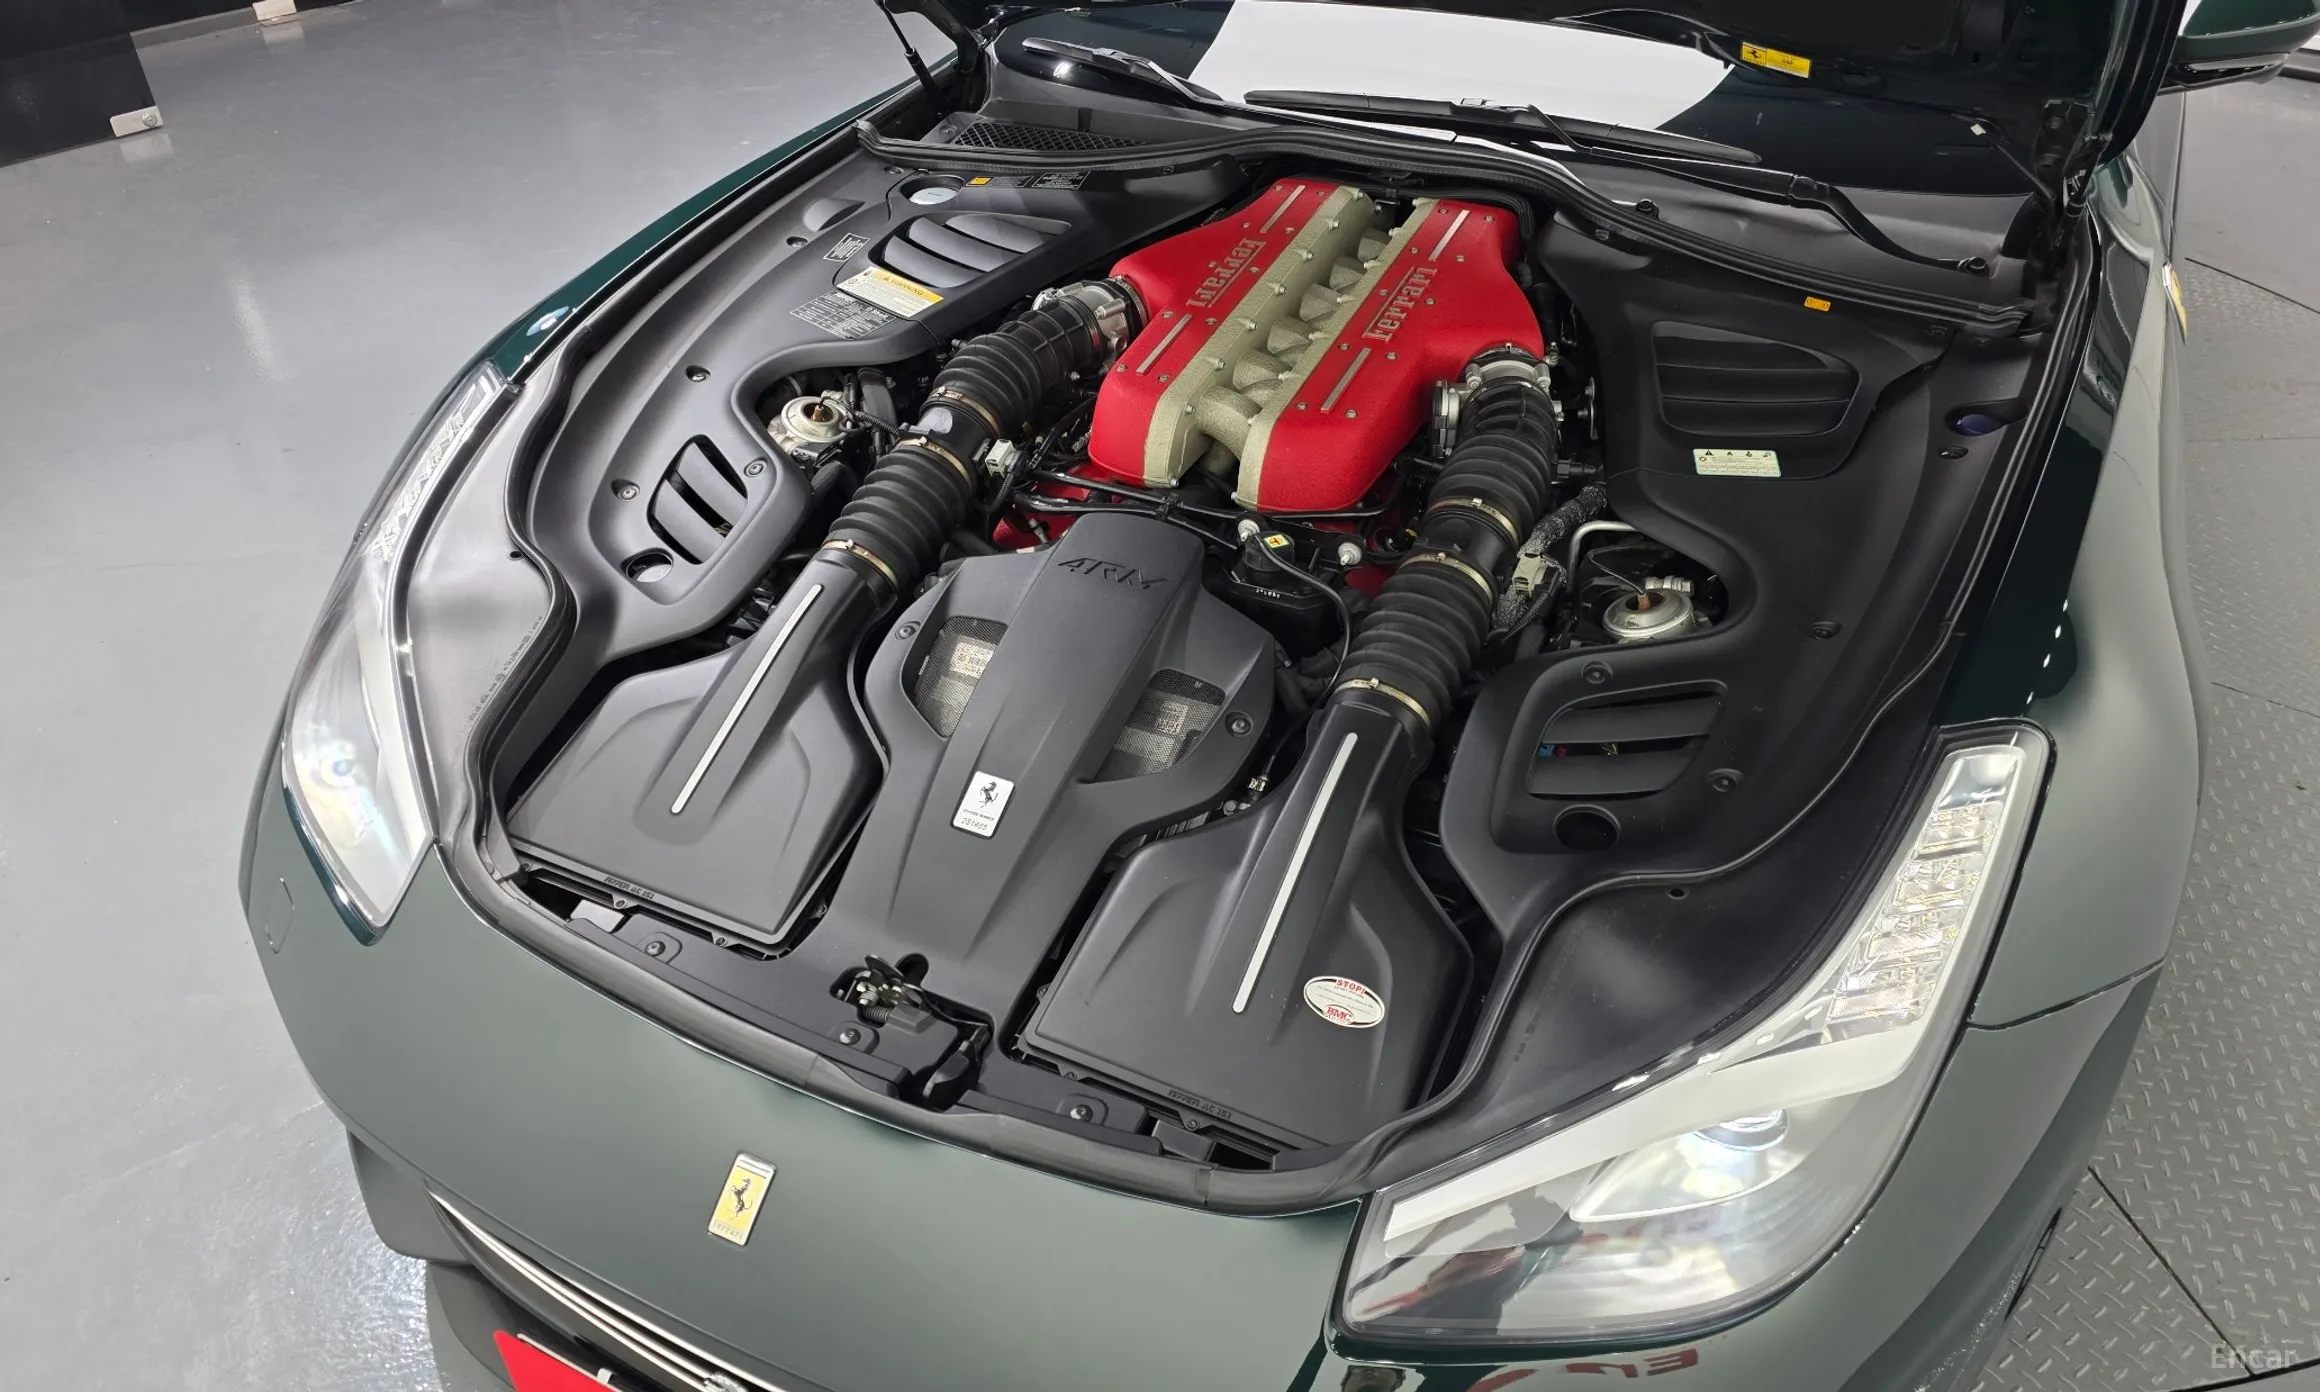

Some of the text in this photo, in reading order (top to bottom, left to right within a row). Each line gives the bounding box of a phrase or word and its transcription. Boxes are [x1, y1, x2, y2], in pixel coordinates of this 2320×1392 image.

[1186, 238, 1267, 308] Ferrari
[1361, 266, 1438, 344] Ferrari
[1336, 979, 1366, 995] STOP!
[1326, 1006, 1352, 1022] BMC
